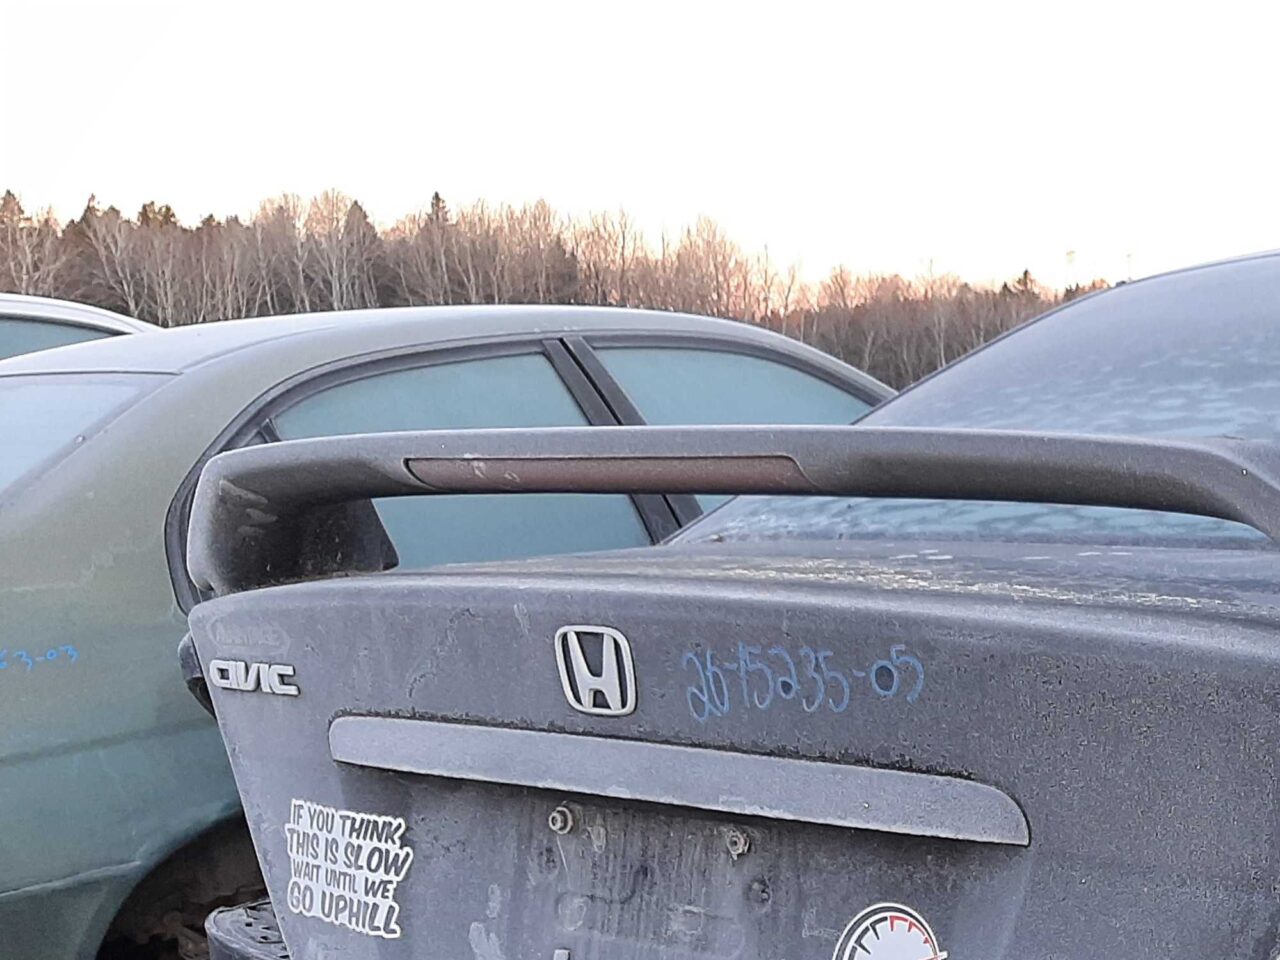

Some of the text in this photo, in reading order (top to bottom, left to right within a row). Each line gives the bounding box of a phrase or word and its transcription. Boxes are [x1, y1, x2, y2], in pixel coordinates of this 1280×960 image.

[209, 659, 299, 695] CIVIC
[291, 803, 403, 845] IF YOU THINK
[286, 828, 411, 877] THIS IS SLOW
[292, 858, 394, 899] WAIT UNTIL WE
[289, 880, 398, 934] GO UPHILL
